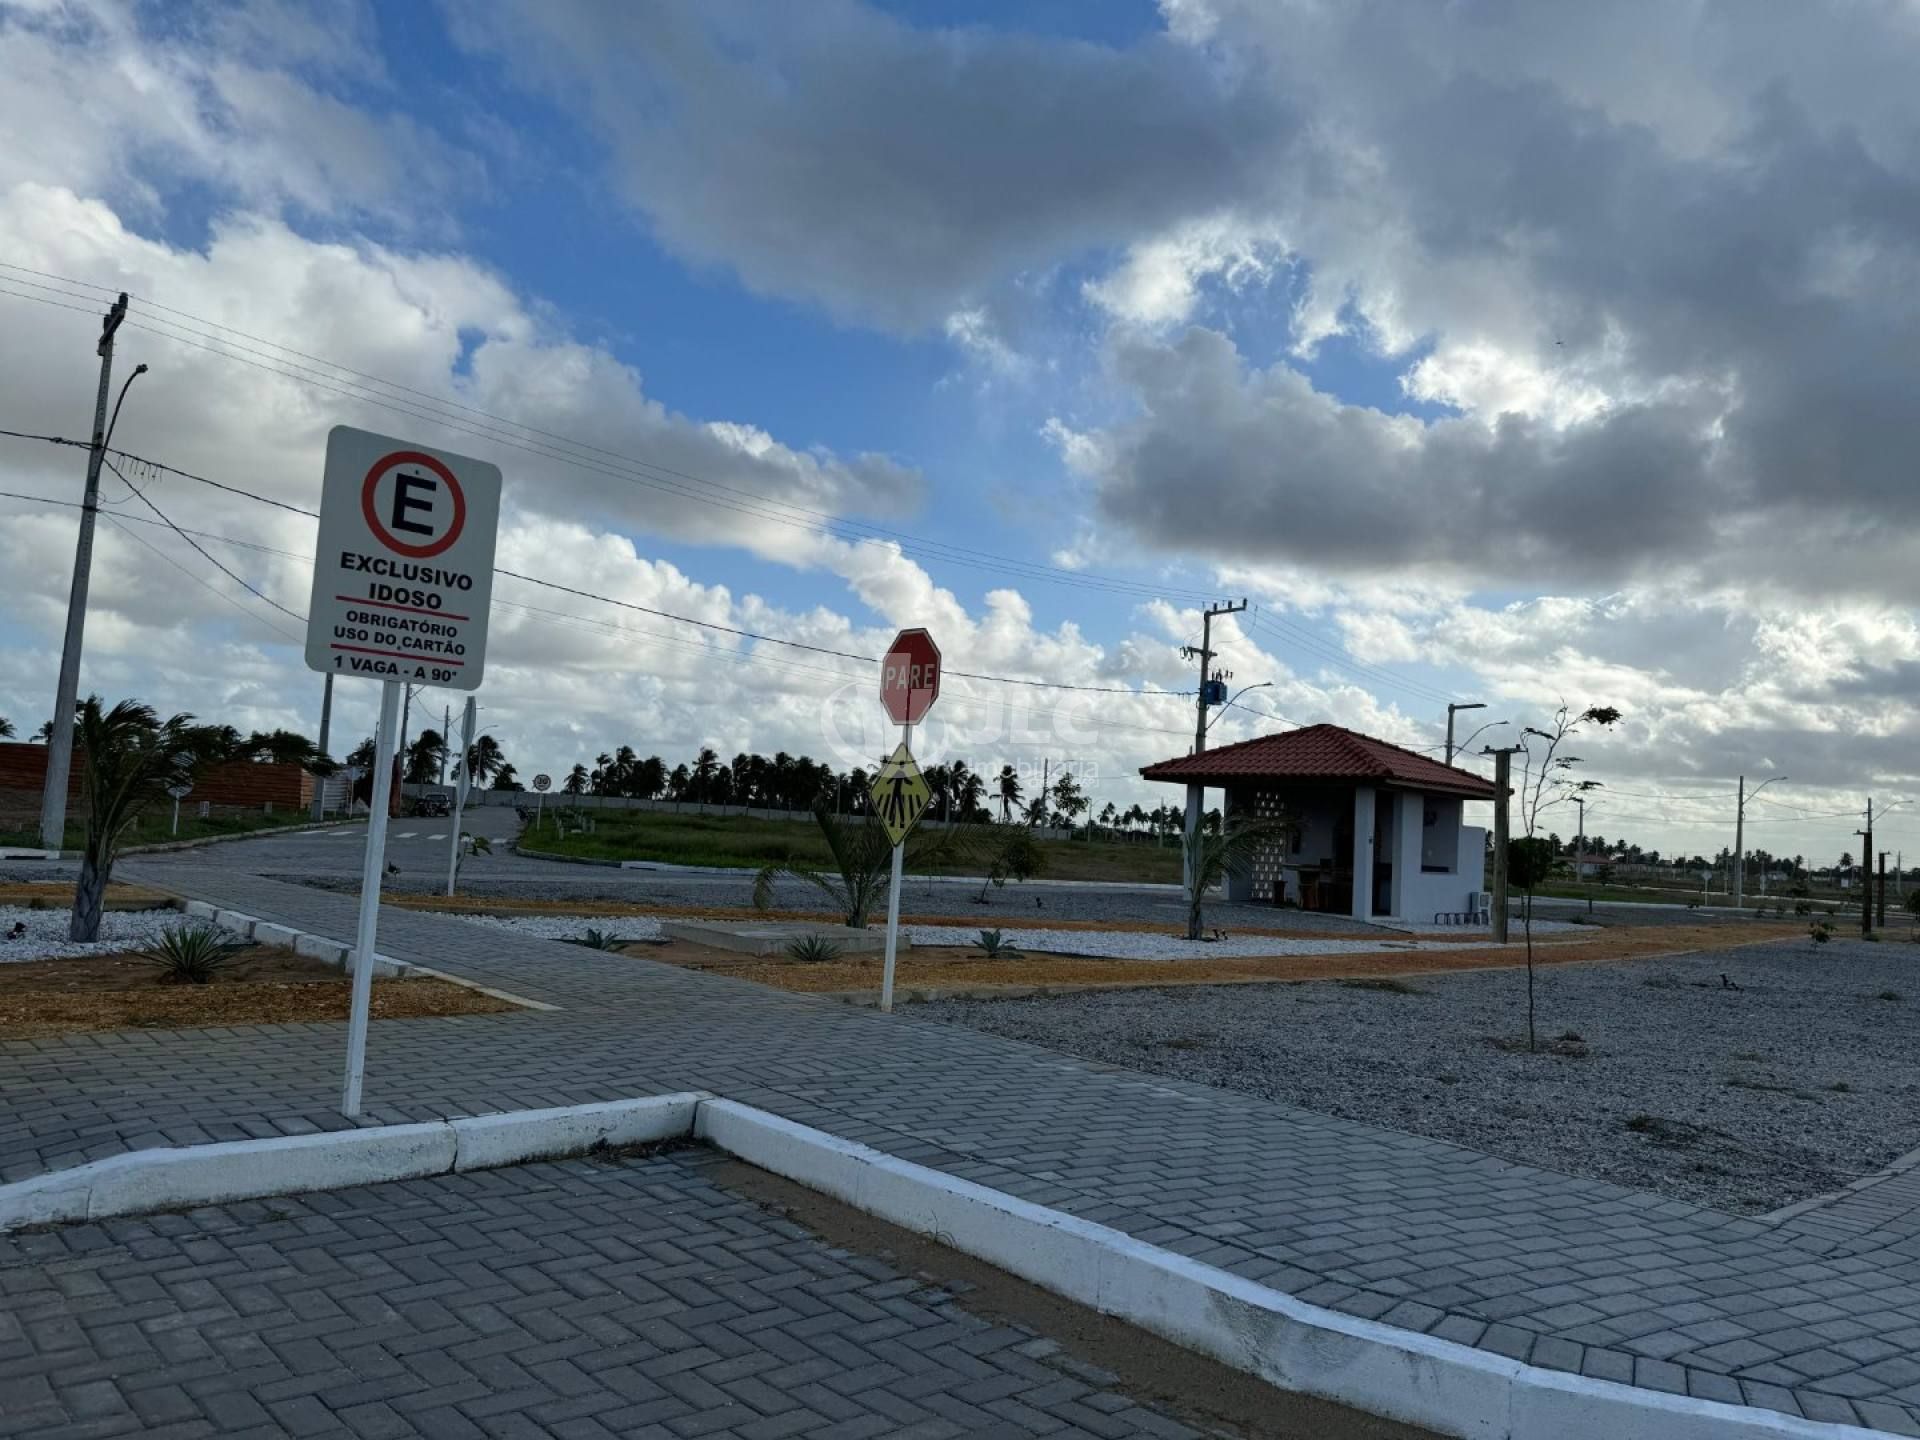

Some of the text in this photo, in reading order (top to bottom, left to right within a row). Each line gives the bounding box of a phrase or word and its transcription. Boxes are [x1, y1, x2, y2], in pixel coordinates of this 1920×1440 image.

[391, 472, 437, 536] E
[340, 551, 473, 591] EXCLUSIVO
[368, 582, 442, 609] IDOSO
[346, 610, 457, 638] OBRIGATÓRIO
[334, 625, 465, 655] USO DO CARTÃO
[334, 655, 343, 668] 1
[350, 656, 398, 675] VAGA
[414, 666, 426, 679] A
[886, 664, 935, 690] PARE
